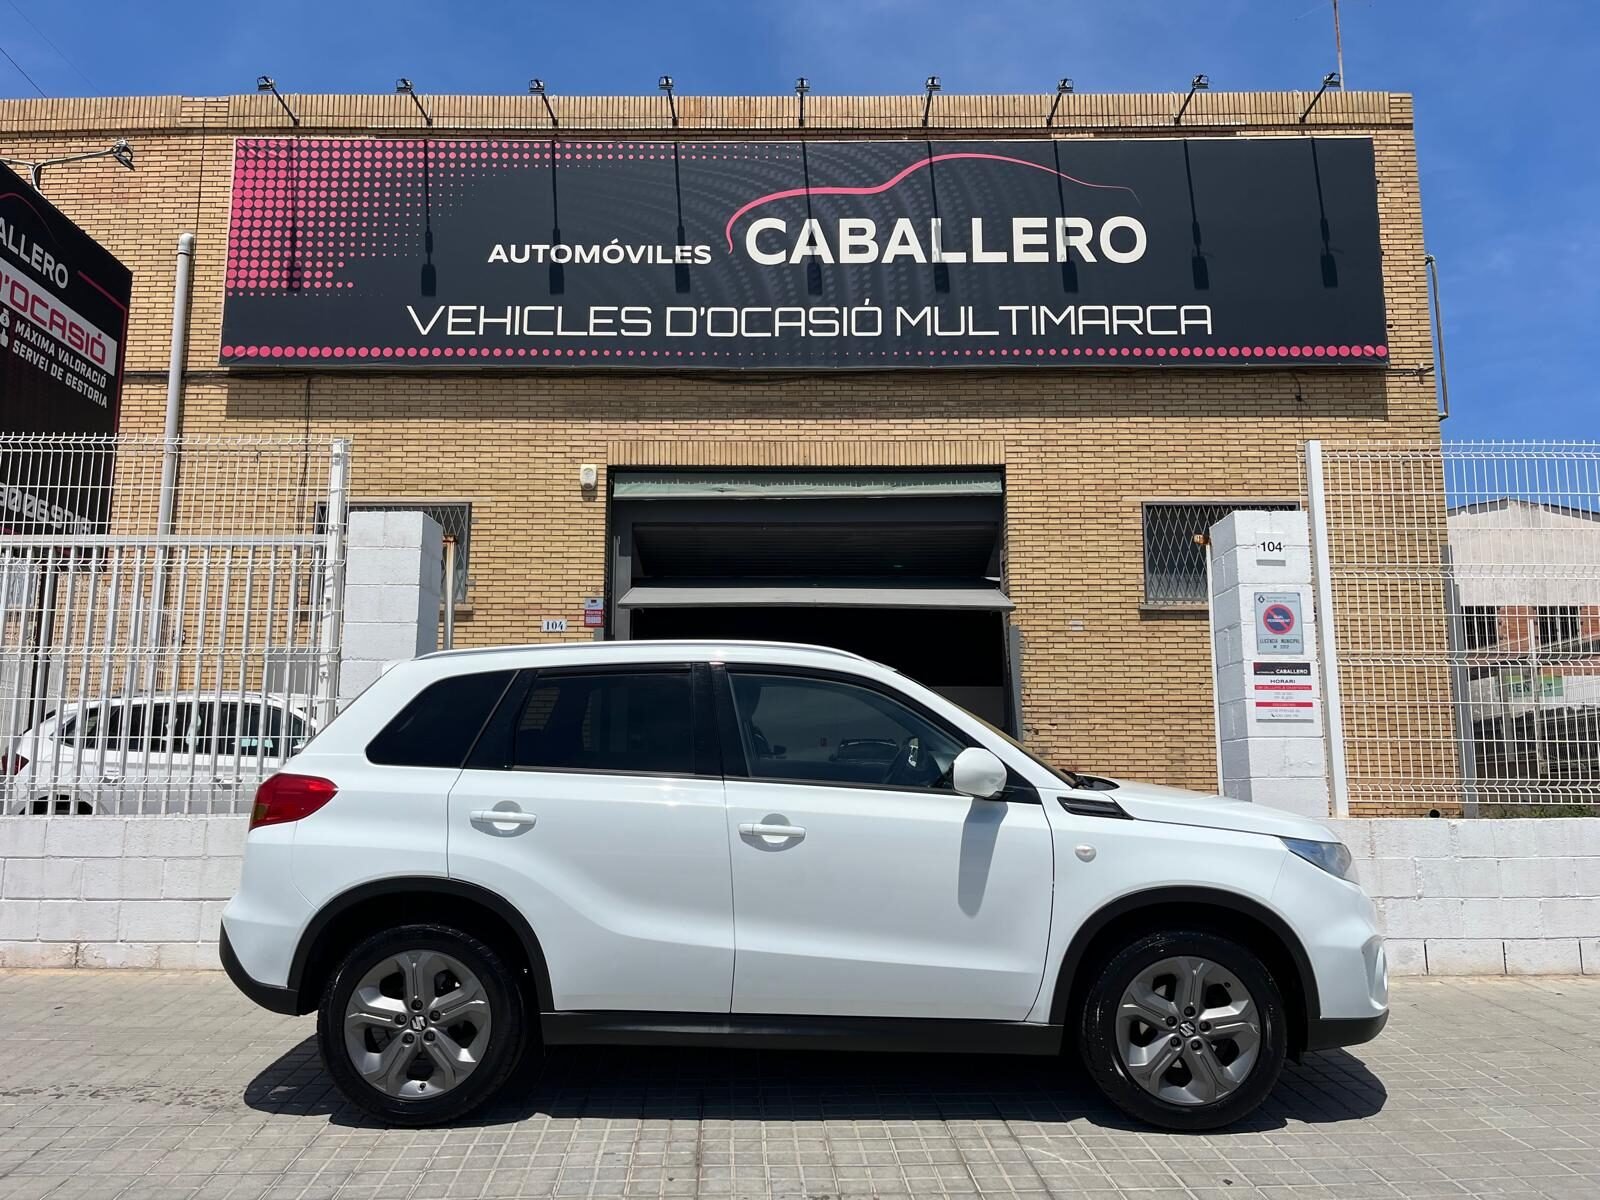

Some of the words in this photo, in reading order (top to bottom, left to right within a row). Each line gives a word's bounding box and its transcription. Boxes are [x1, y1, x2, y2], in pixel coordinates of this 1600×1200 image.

[488, 238, 712, 266] AUTOMÓVILES
[745, 215, 1148, 266] CABALLERO
[0, 270, 107, 366] 'OCASIÓ
[407, 305, 652, 337] VEHICLES
[665, 297, 883, 338] D'OCASIÓ
[896, 304, 1213, 337] MULTIMARCA
[12, 339, 49, 372] SERVEI
[50, 362, 65, 381] DE
[65, 373, 108, 409] GESTORIA
[15, 320, 55, 357] MÀXIMA
[58, 347, 107, 389] VALORACIÓ
[1260, 541, 1283, 553] 104
[545, 621, 564, 631] 104
